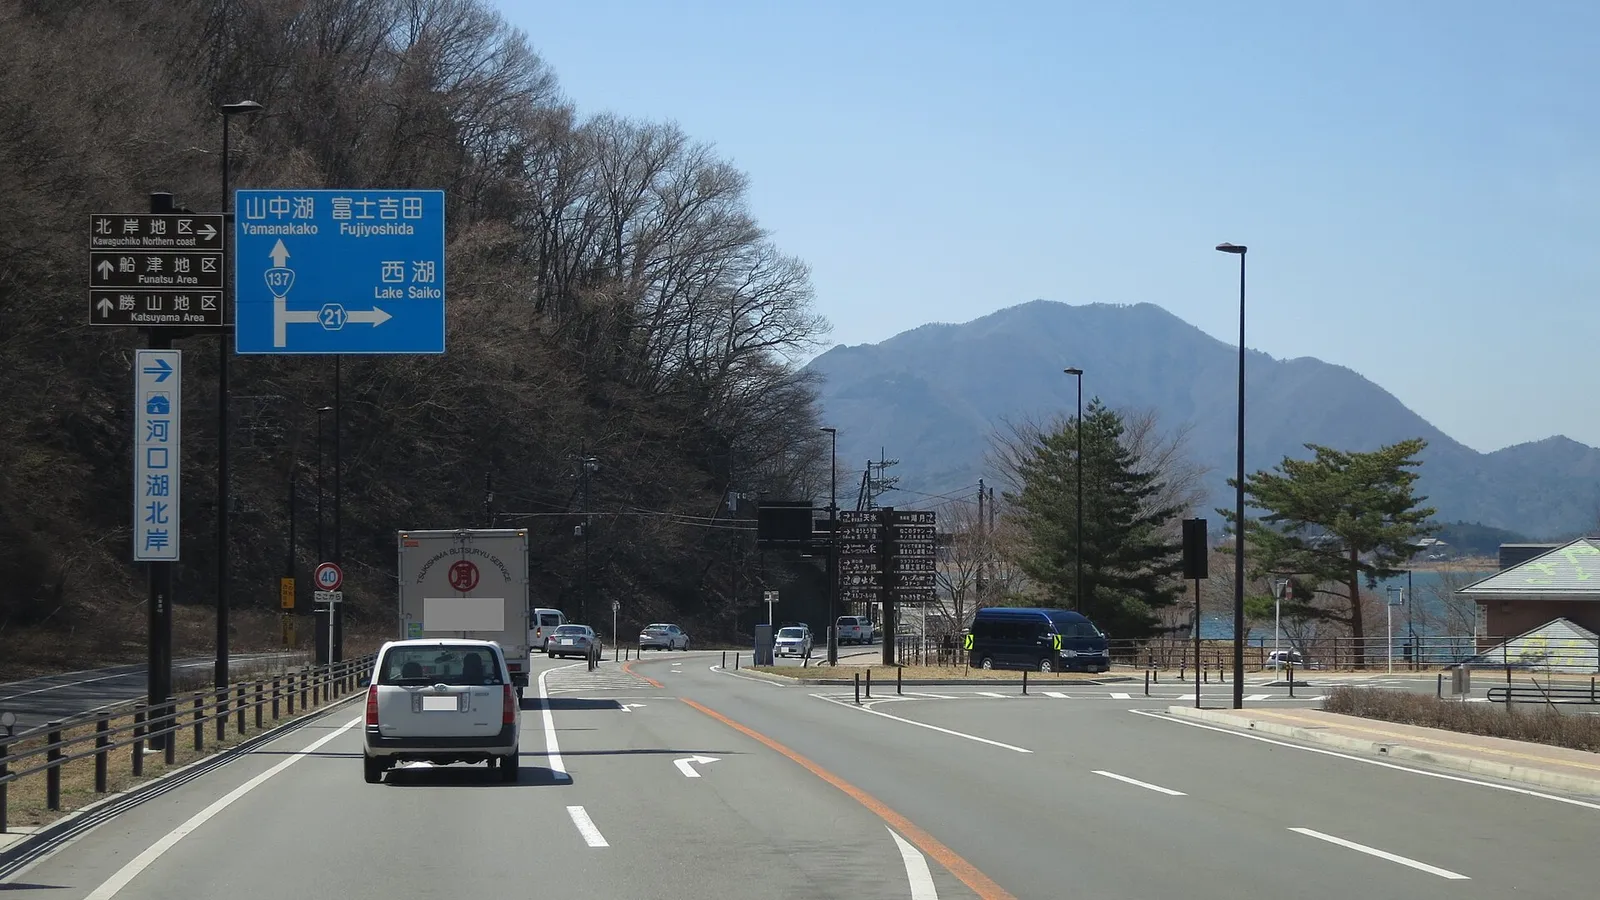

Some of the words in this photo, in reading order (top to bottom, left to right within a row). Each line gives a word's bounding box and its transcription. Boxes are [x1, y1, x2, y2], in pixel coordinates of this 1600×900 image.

[246, 196, 314, 220] 山中湖
[332, 197, 423, 220] 富士吉田
[96, 218, 192, 234] 北岸地区
[242, 223, 318, 235] Yamanakako
[340, 223, 413, 237] Fujiyoshida
[93, 237, 140, 246] Kawaguchiko
[143, 237, 174, 246] Northern
[176, 238, 196, 246] coast
[120, 257, 216, 273] 船津地区
[381, 261, 435, 283] 西湖
[138, 275, 173, 284] Funatsu
[177, 275, 198, 284] Area
[268, 273, 289, 286] 137
[375, 287, 403, 298] Lake
[408, 287, 440, 299] Saiko
[119, 295, 216, 310] 勝山地区
[131, 313, 180, 323] Katsuyama
[184, 313, 204, 322] Area
[324, 309, 341, 325] 21
[145, 419, 170, 551] 河口湖北岸
[417, 551, 448, 584] TSUKISHIMA
[450, 548, 490, 558] BUTSURYU
[490, 556, 511, 583] SERVICE
[321, 571, 336, 583] 40
